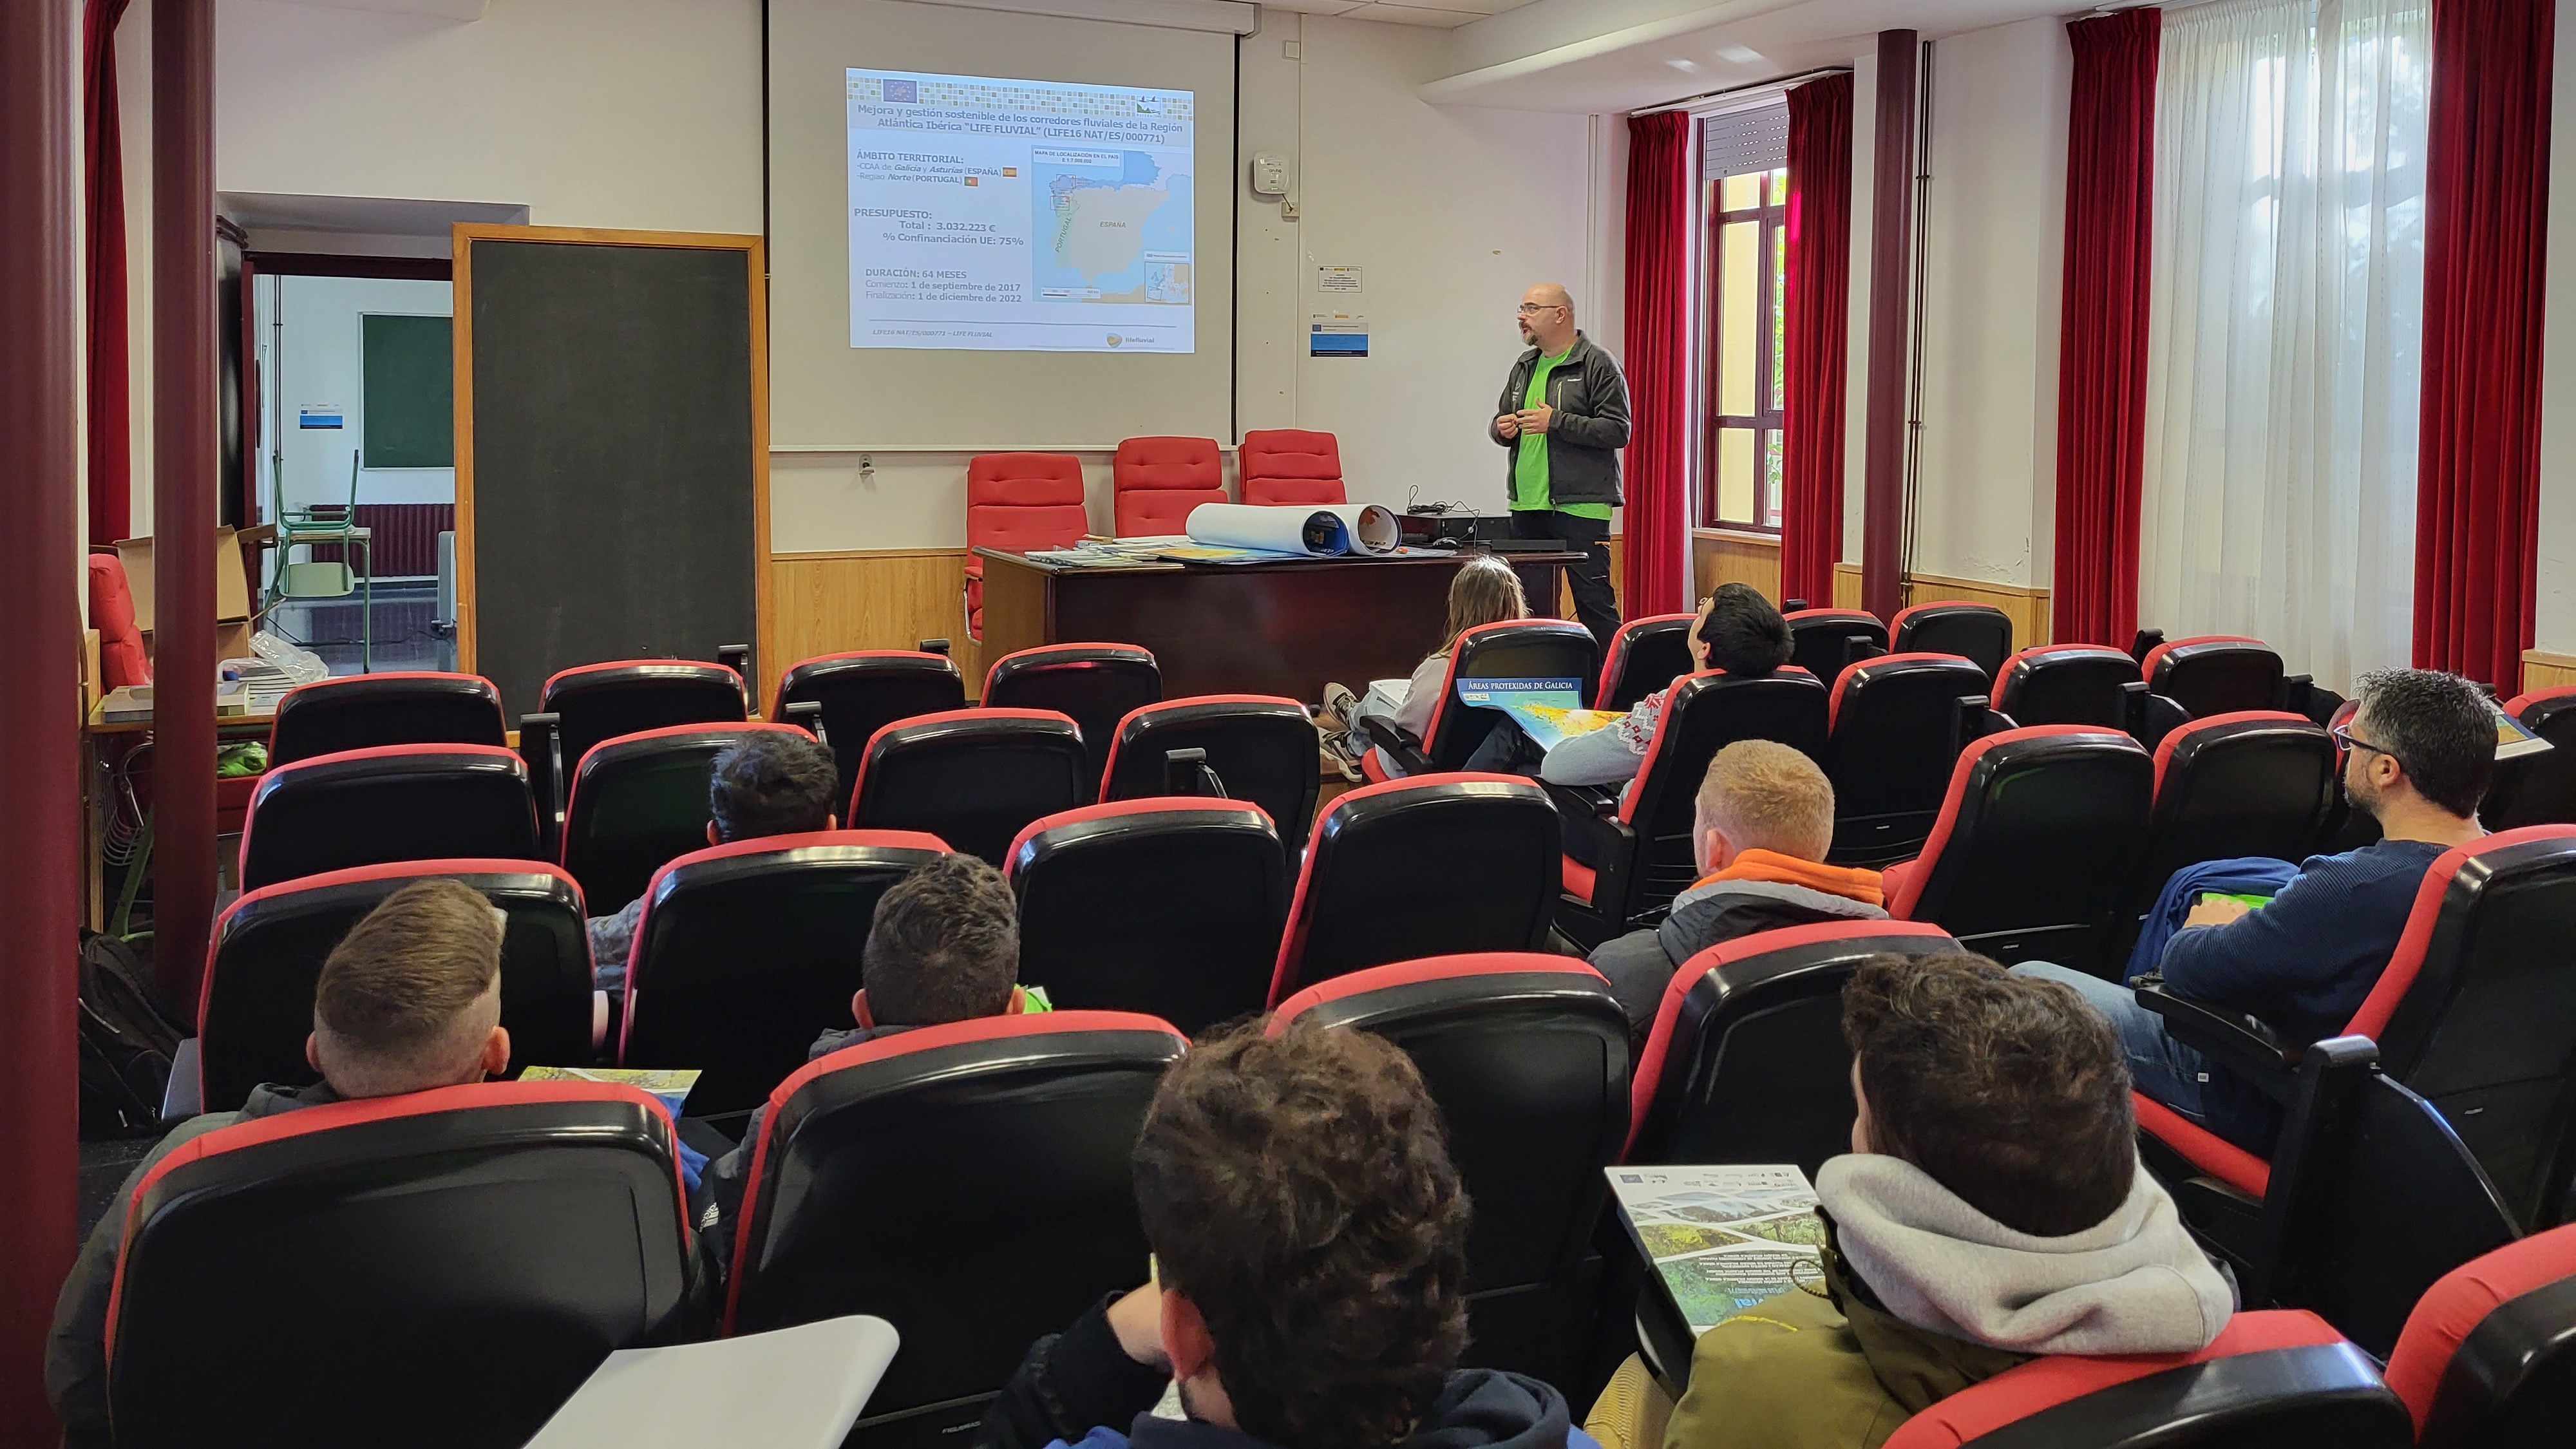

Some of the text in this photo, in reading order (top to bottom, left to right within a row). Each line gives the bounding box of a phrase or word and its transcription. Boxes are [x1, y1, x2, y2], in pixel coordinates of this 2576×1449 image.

[858, 104, 1182, 133] Mejora y gestión sostenible de los corredores fluviales de la Región
[878, 118, 923, 129] Atlántica
[926, 120, 961, 130] Ibérica
[1043, 128, 1081, 138] (LIFE16
[1084, 129, 1165, 144] NAT/ES/000771)
[857, 149, 964, 164] ÁMBITO TERRITORIAL:
[965, 167, 1002, 177] (ESPAÑA)
[887, 173, 911, 182] Norte
[913, 175, 962, 184] (PORTUGAL)
[854, 208, 933, 219] PRESUPUESTO:
[899, 220, 924, 230] Total
[936, 222, 987, 232] 3.032.223
[883, 232, 1024, 245] % Confinanciación UE: 75%
[1055, 216, 1072, 252] PORTUGAL
[866, 267, 967, 279] DURACIÓN: 64 MESES
[866, 279, 1021, 292] Comienzo: 1 de septiembre de 2017
[866, 291, 1022, 303] Finalización: 1 de diciembre de 2022
[1468, 681, 1489, 690] ÁREAS
[1491, 681, 1532, 690] PROTEXIDAS
